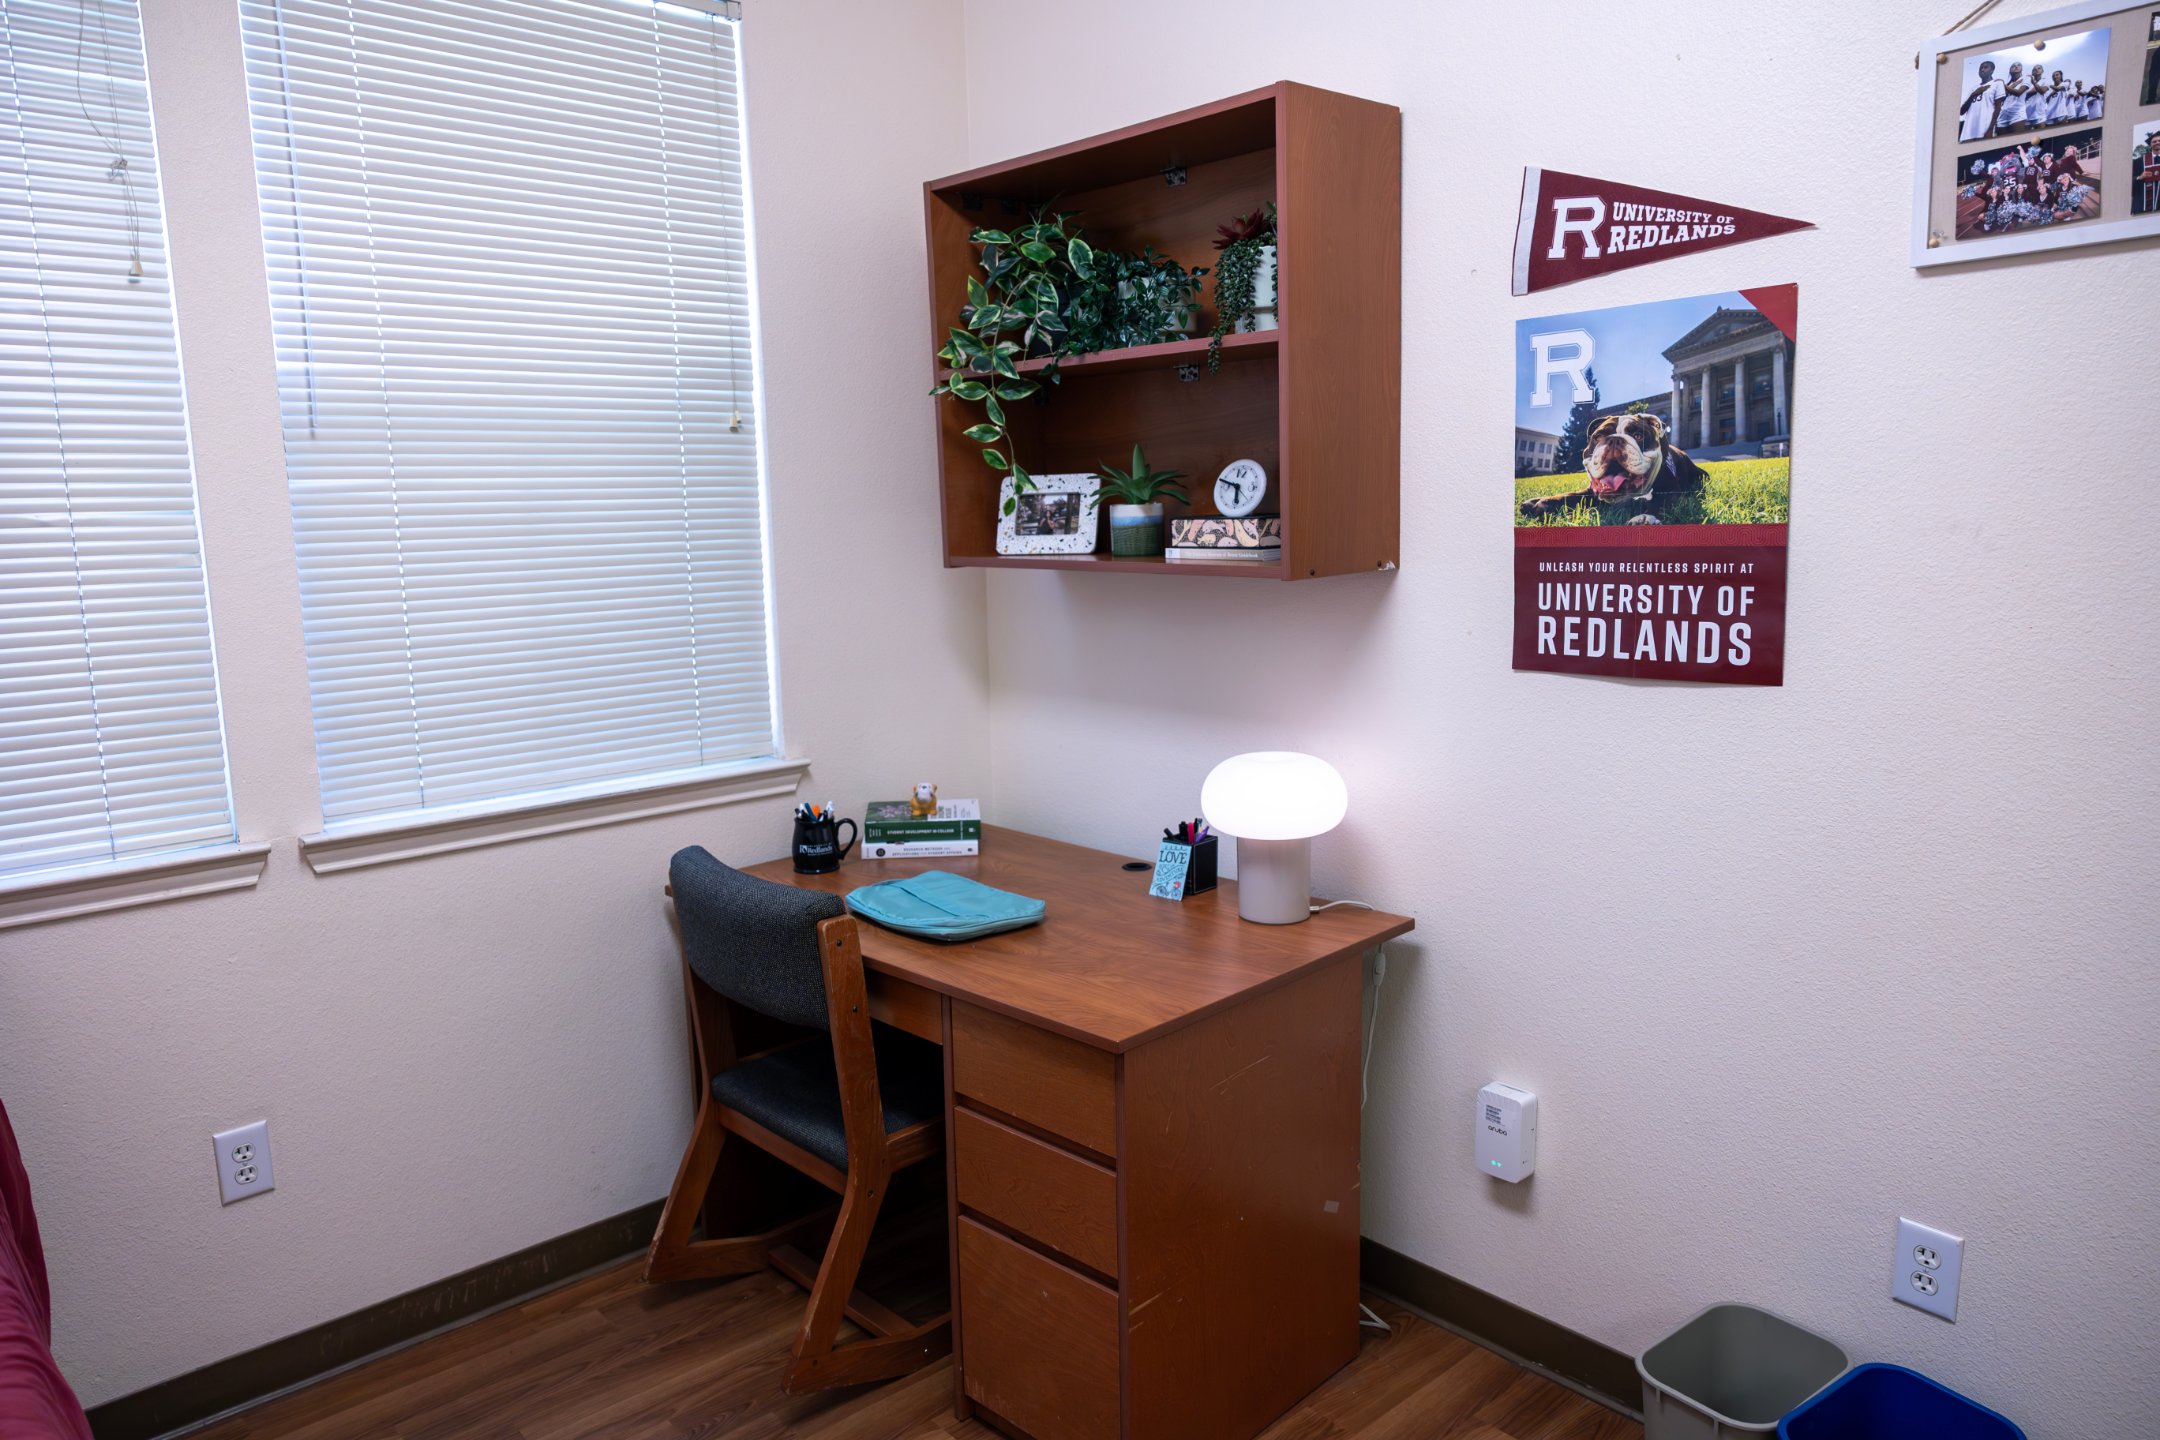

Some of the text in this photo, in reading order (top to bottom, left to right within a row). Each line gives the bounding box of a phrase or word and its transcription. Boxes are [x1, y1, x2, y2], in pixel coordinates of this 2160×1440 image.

[1547, 196, 1607, 260] R
[1612, 201, 1735, 225] UNIVERSITY OF
[1607, 223, 1737, 255] REDLANDS
[1530, 328, 1596, 408] R
[1539, 562, 1755, 574] UNLEASH YOUR RELENTLESS SPIRIT AT
[1538, 582, 1755, 617] UNIVERSITY OF
[1537, 615, 1752, 666] REDLANDS
[1159, 850, 1188, 864] LOVE
[1487, 1125, 1508, 1136] aruba
